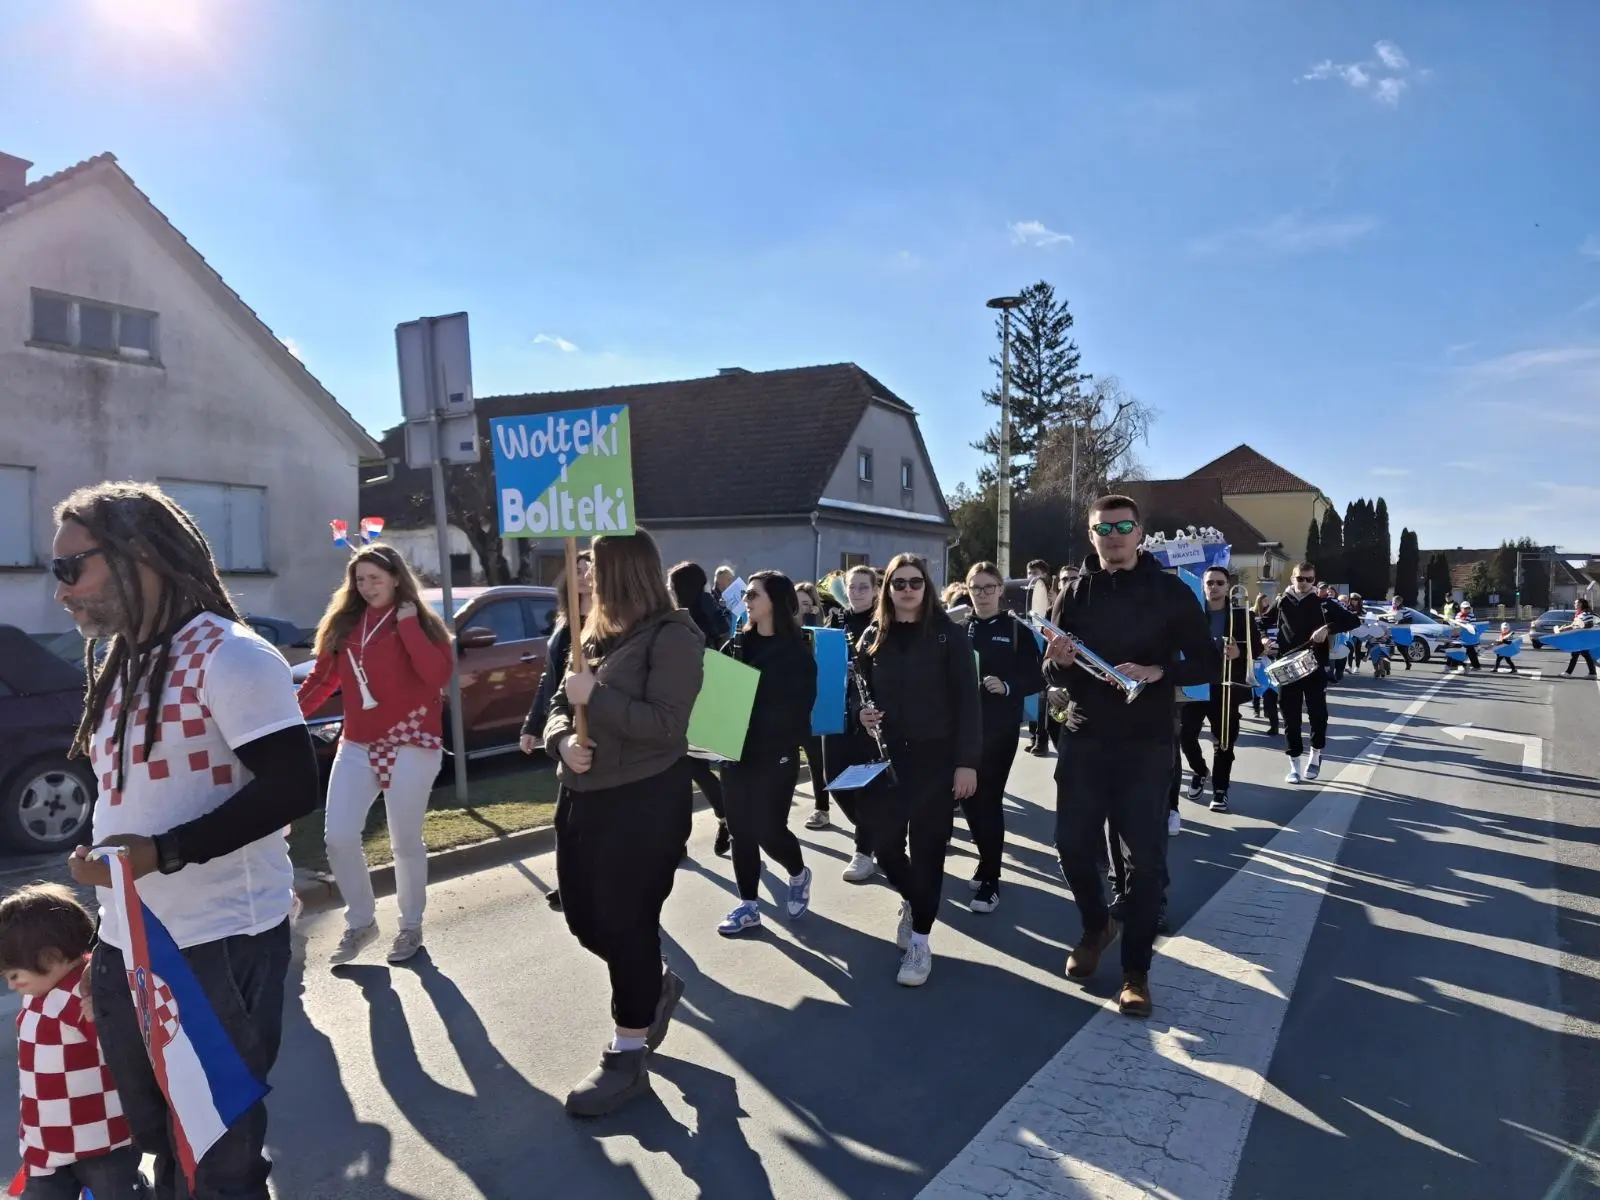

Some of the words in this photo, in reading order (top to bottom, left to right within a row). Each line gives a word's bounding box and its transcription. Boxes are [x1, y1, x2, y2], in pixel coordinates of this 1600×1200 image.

[496, 410, 618, 460] Wolteki
[558, 453, 568, 483] i
[501, 484, 628, 533] Bolteki
